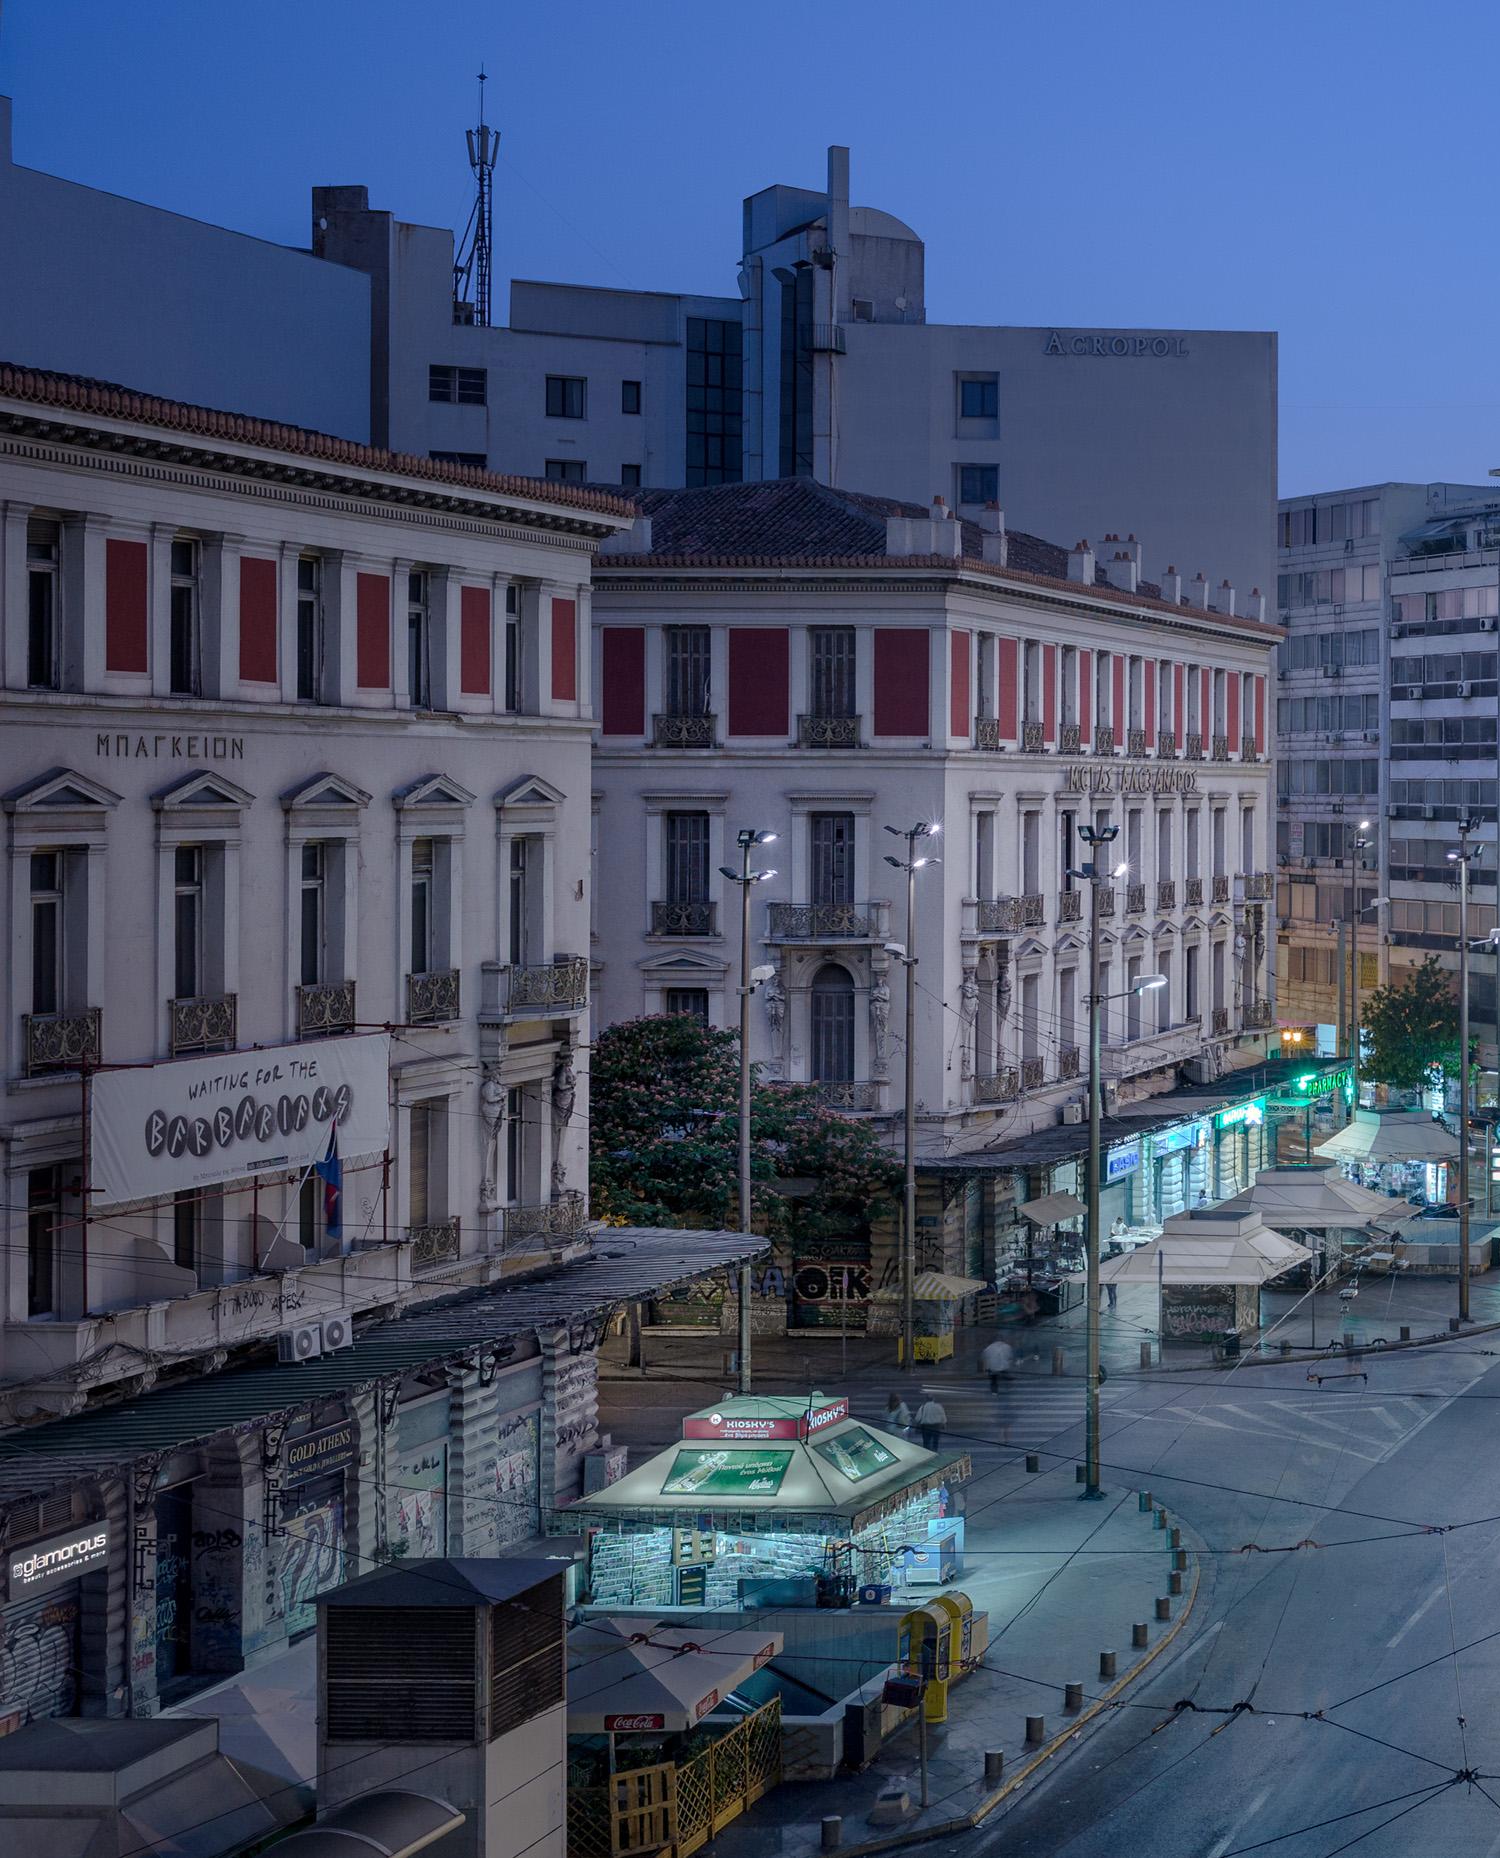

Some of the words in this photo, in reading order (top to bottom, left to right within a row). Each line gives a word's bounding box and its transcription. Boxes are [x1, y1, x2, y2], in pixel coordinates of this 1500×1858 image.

[97, 733, 243, 759] ΜΠΑΓΚΕΙΟΝ
[189, 1071, 249, 1101] WAITING
[256, 1065, 283, 1084] FOR
[290, 1060, 317, 1078] THE
[1307, 1071, 1347, 1096] PHARMACY
[727, 1421, 775, 1429] KIOSKY'S
[289, 1442, 315, 1464] GOLD
[316, 1428, 351, 1455] ATHENS
[24, 1534, 106, 1577] glamorous
